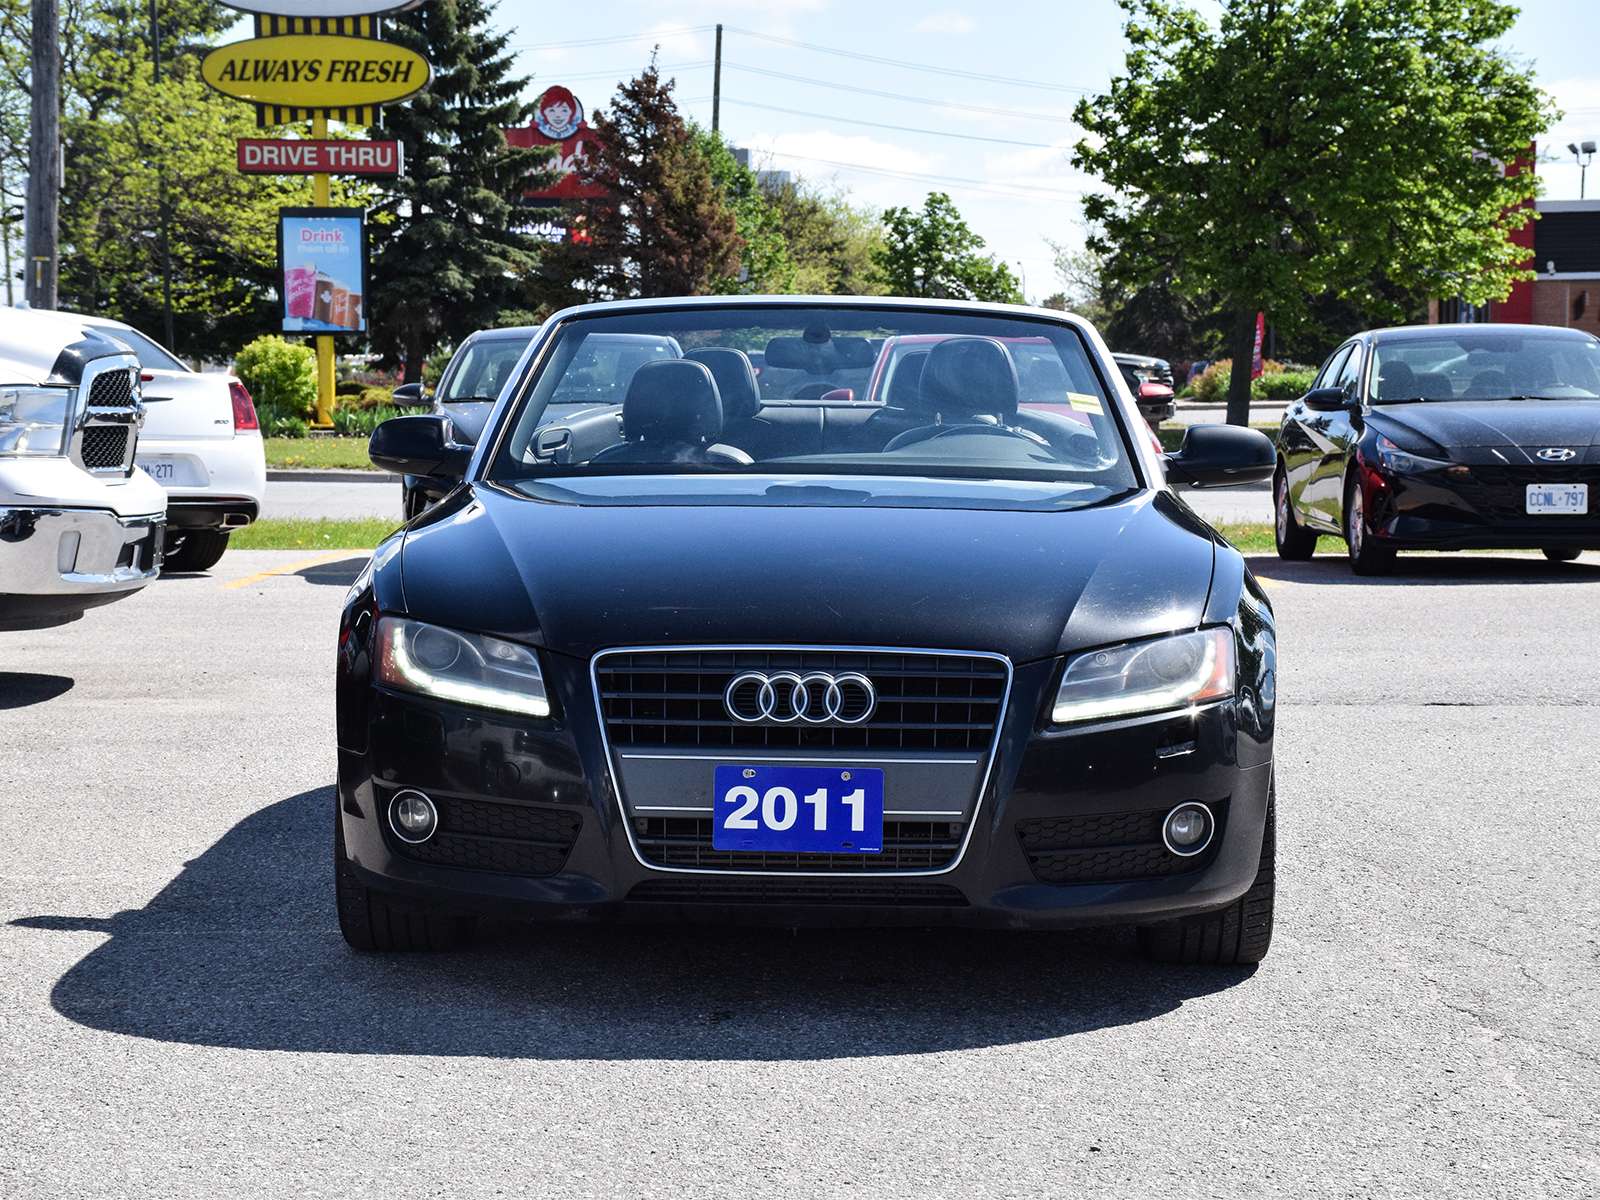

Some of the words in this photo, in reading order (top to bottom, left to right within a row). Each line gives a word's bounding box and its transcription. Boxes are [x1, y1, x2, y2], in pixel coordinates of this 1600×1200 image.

[218, 59, 322, 83] ALWAYS
[325, 59, 415, 83] FRESH
[244, 146, 318, 166] DRIVE
[325, 146, 392, 168] THRU
[301, 229, 343, 242] Drink
[723, 785, 865, 832] 2011
